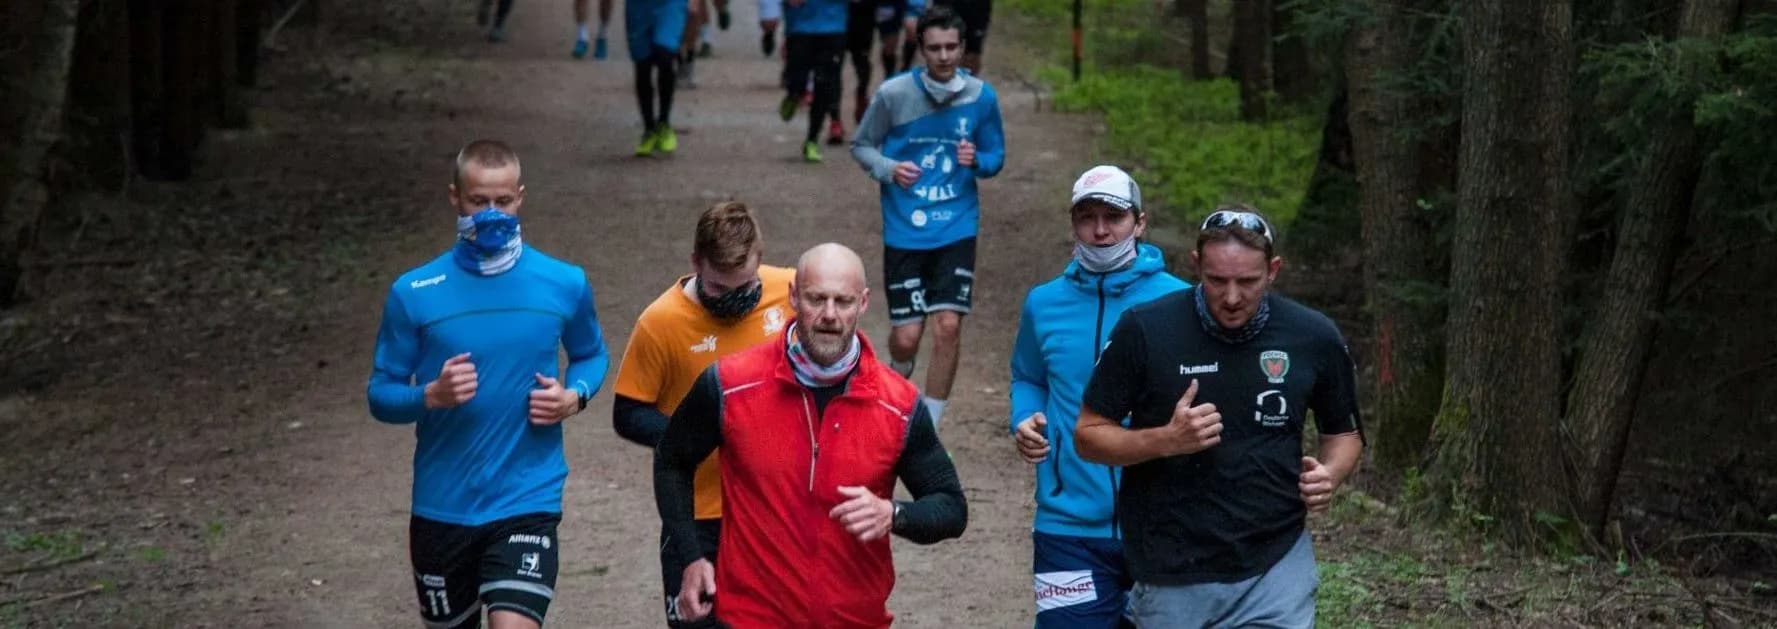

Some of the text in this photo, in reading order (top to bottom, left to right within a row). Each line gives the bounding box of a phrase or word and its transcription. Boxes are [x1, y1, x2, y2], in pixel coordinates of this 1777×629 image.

[1180, 361, 1218, 374] hummel
[508, 534, 541, 544] Allianz
[426, 589, 450, 616] 11
